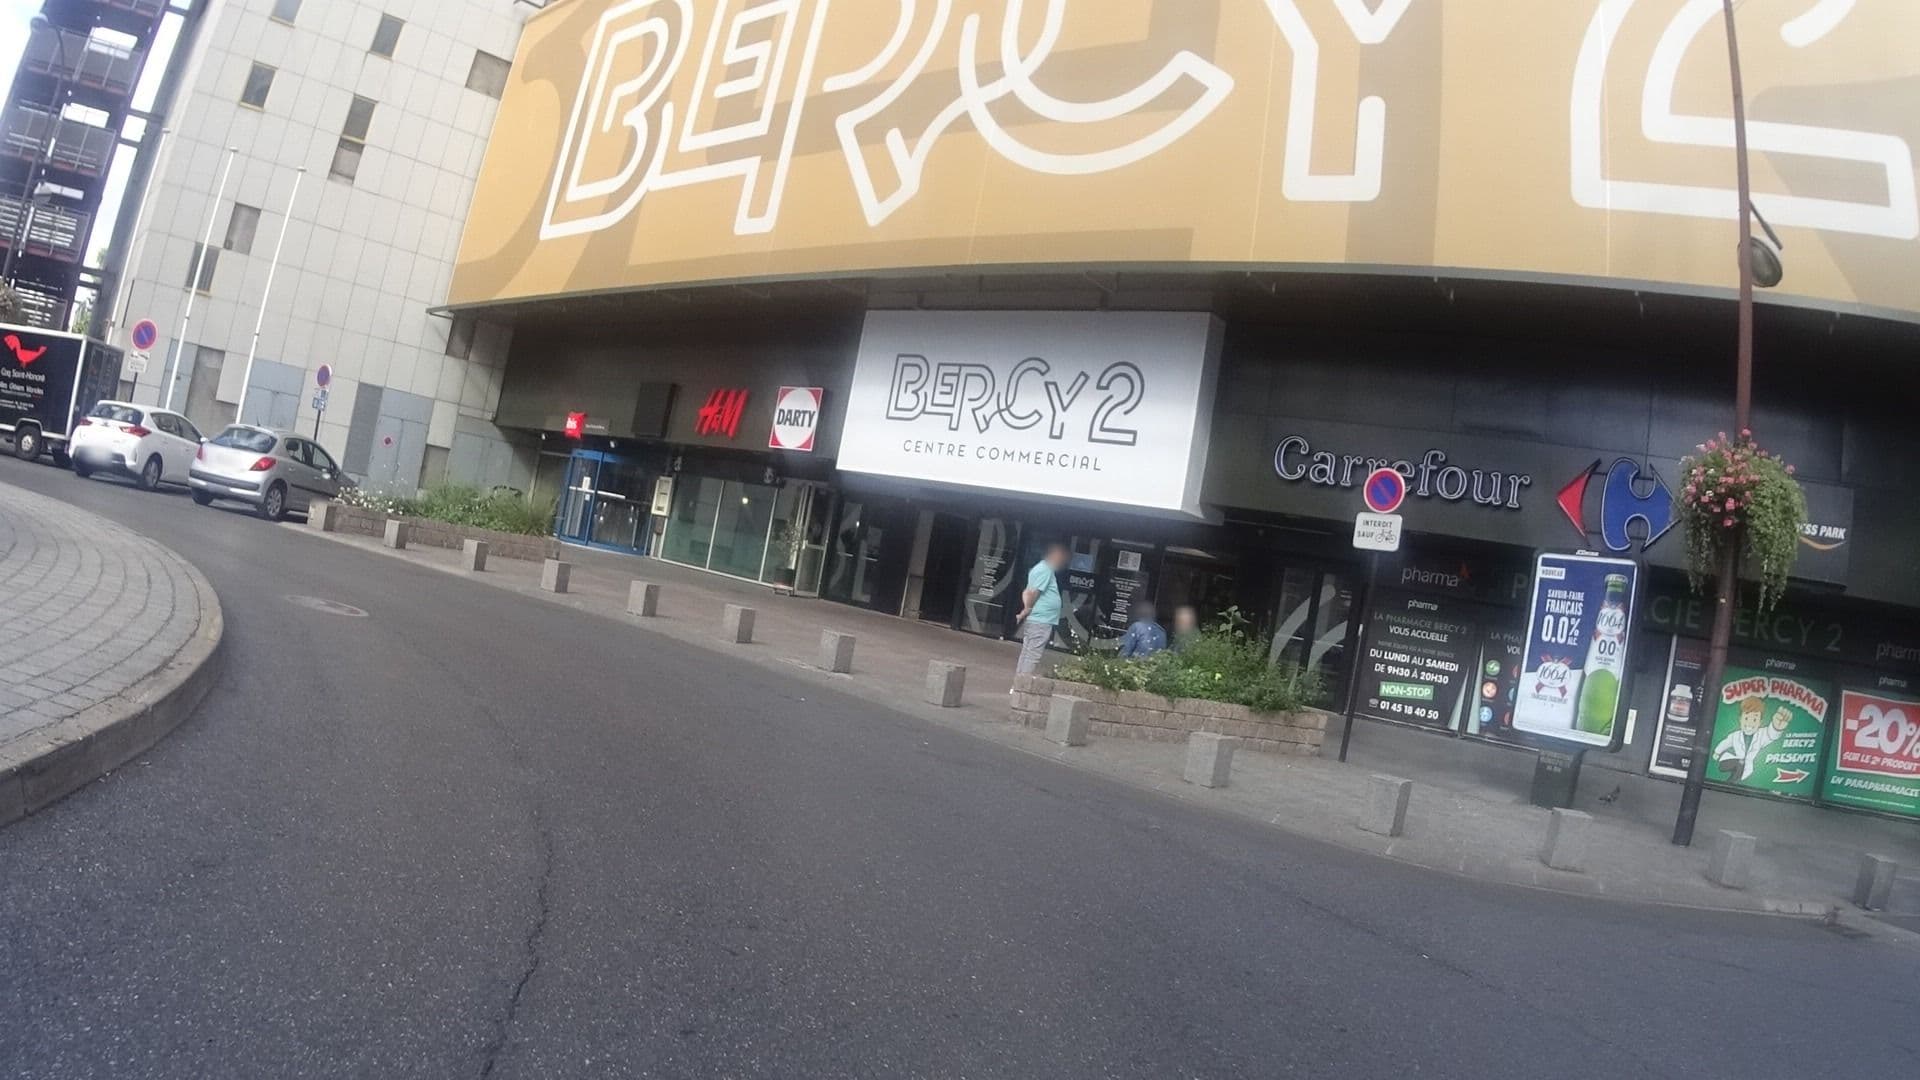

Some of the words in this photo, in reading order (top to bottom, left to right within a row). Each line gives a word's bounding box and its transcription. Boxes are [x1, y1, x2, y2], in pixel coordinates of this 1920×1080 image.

[886, 354, 1090, 440] BERCY
[1088, 361, 1145, 446] 2
[696, 389, 748, 438] H&M
[776, 408, 816, 428] DARTY
[903, 439, 966, 458] CENTRE
[976, 446, 1101, 471] COMMERCIAL
[1363, 519, 1393, 529] INTERDIT
[1819, 524, 1847, 541] PARK
[1357, 530, 1375, 539] SAUF
[1401, 566, 1459, 587] pharma
[1547, 588, 1585, 602] SAVOIR-FAIRE
[1407, 600, 1438, 611] pharma
[1545, 599, 1584, 616] FRANÇAIS
[1374, 612, 1384, 621] LA
[1389, 625, 1410, 637] VOUS
[1410, 628, 1449, 643] ACCUEILLE
[1502, 633, 1523, 644] PHA
[1735, 607, 1815, 645] ERCY
[1824, 623, 1843, 652] 2
[1876, 641, 1920, 661] pharm
[1370, 649, 1384, 659] DU
[1384, 650, 1410, 663] LUNDI
[1412, 655, 1424, 666] AU
[1425, 657, 1458, 672] SAMEDI
[1765, 657, 1796, 671] pharma
[1374, 663, 1385, 673] DE
[1387, 665, 1410, 677] 9H30
[1419, 672, 1449, 685] 20H30
[1381, 684, 1431, 698] NON-STOP
[1723, 678, 1767, 701] SUPER
[1770, 679, 1825, 717] PHARMA
[1380, 701, 1389, 711] 01
[1390, 702, 1402, 712] 45
[1403, 703, 1413, 714] 18
[1414, 706, 1426, 717] 40
[1427, 708, 1439, 720] 50
[1842, 751, 1860, 762] SUR
[1861, 753, 1873, 764] LE
[1880, 757, 1919, 772] PRODUIT
[1830, 775, 1844, 785] EN
